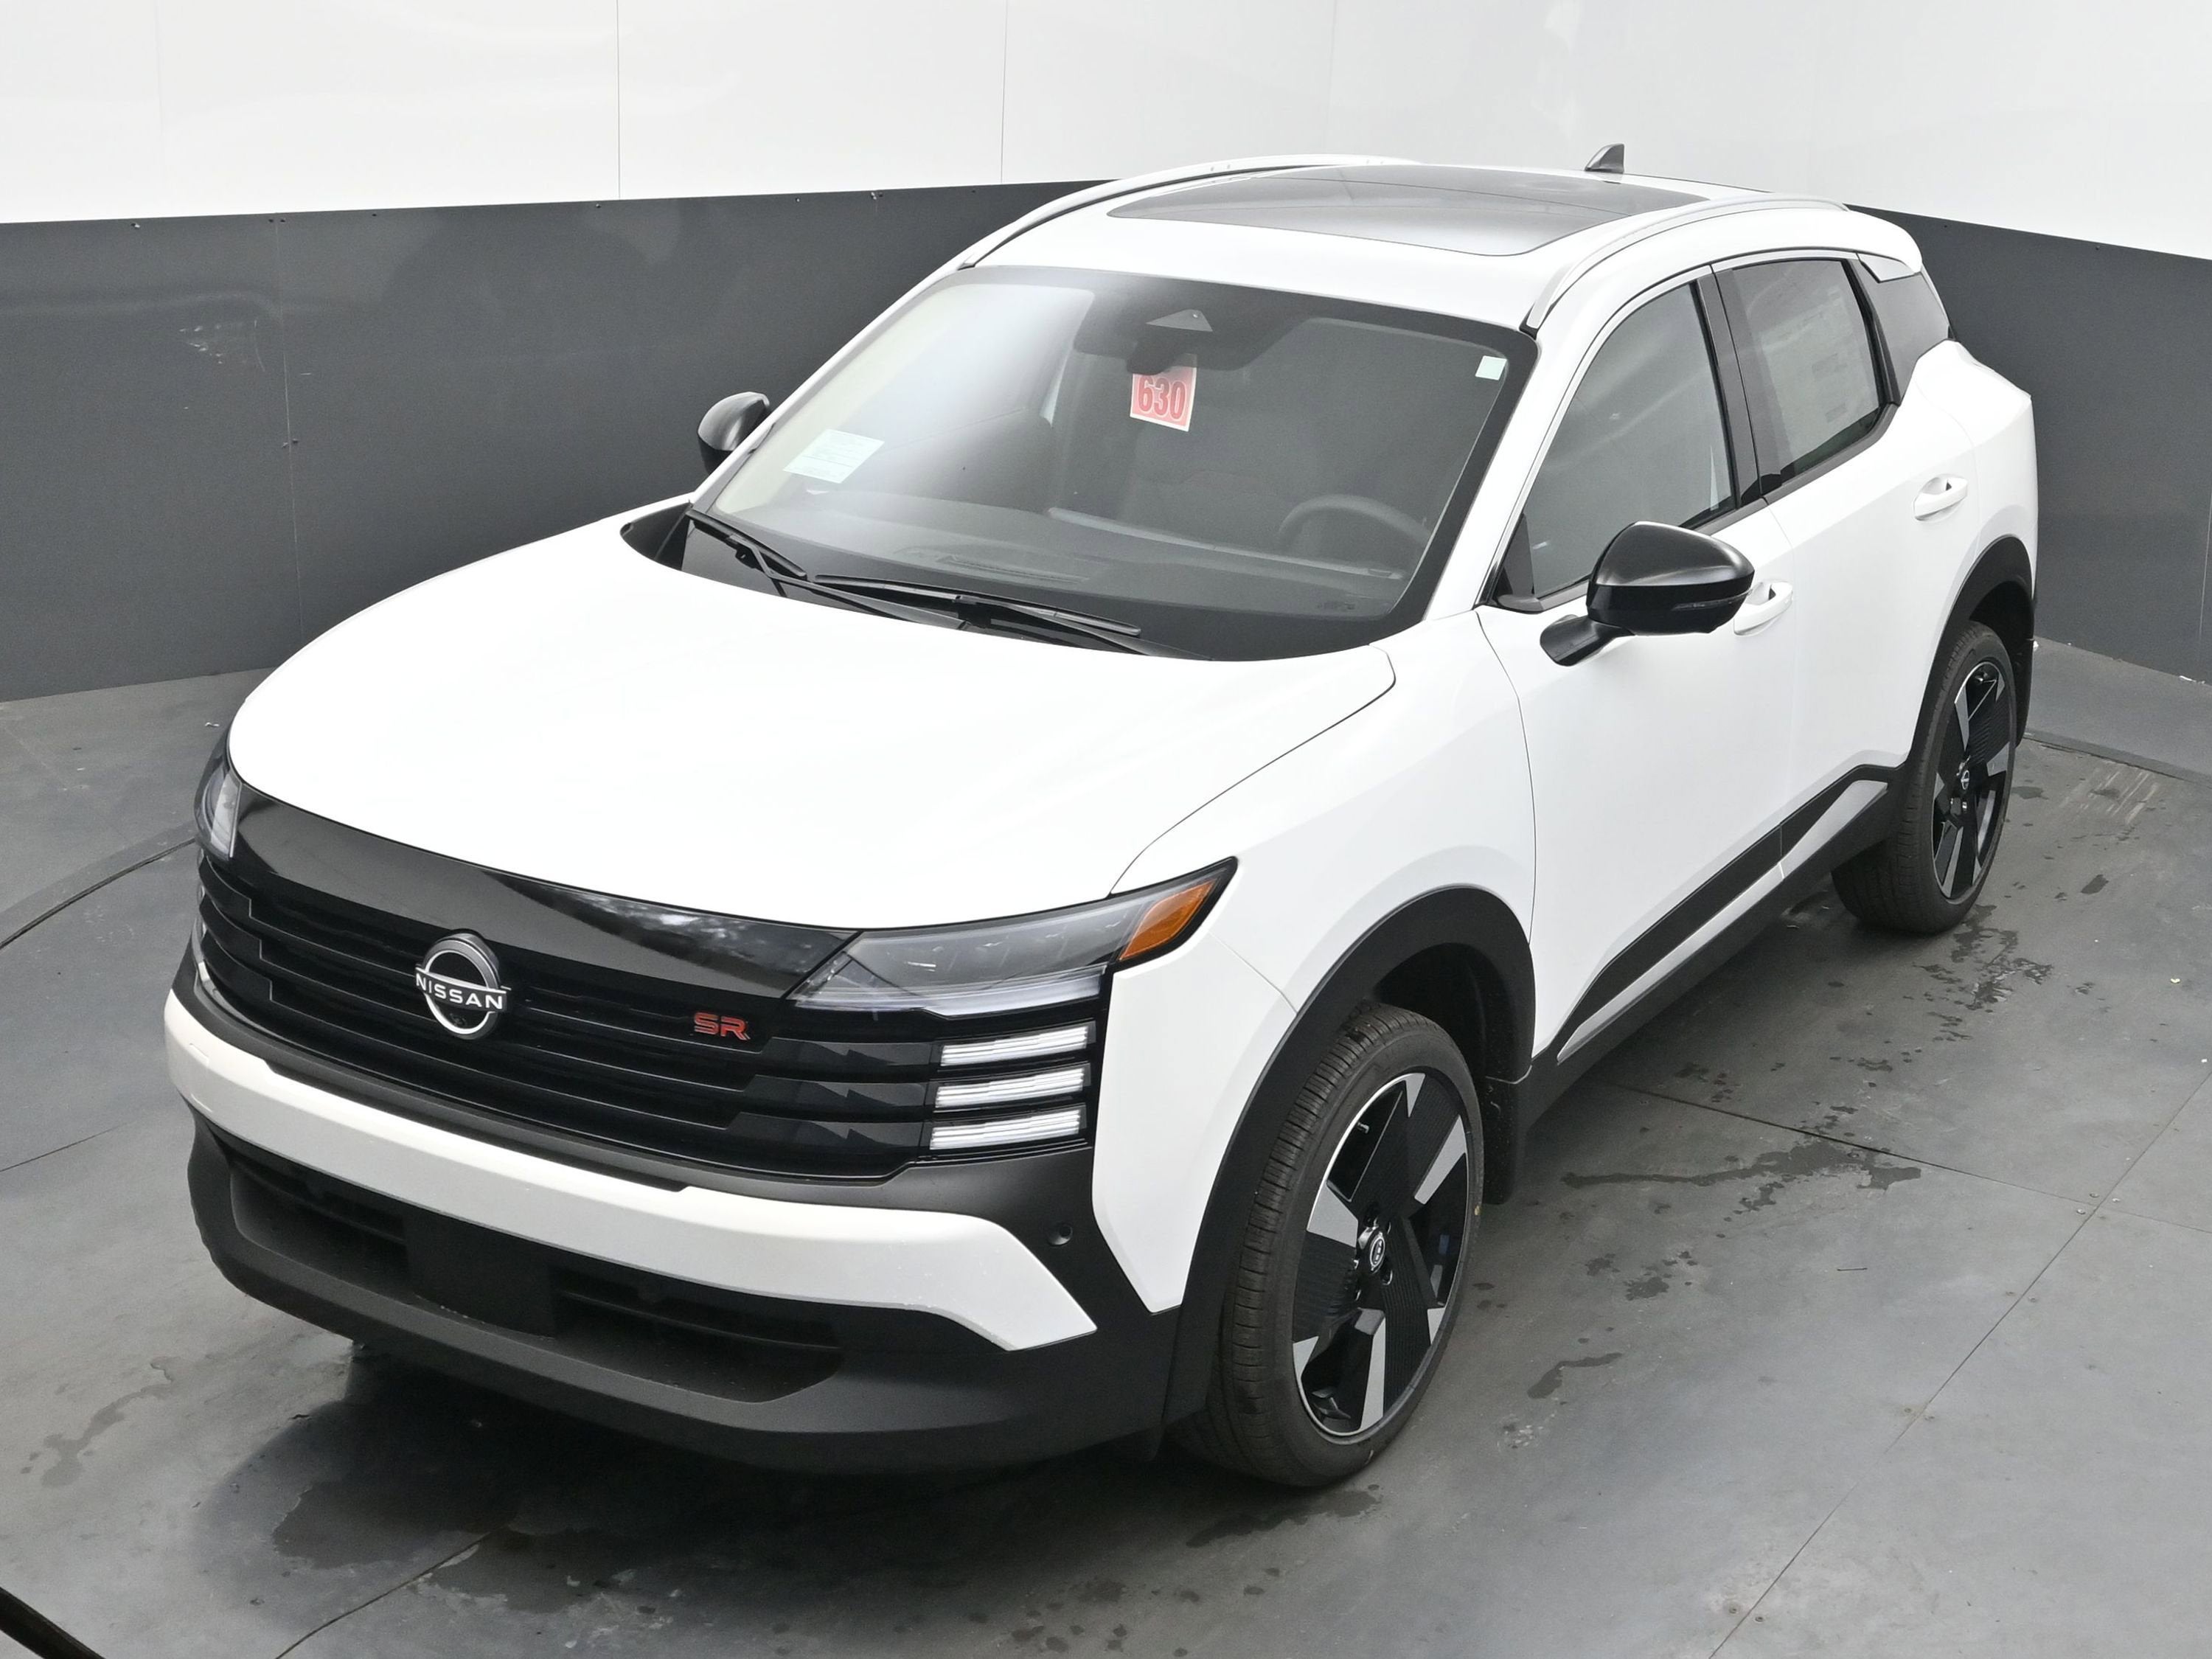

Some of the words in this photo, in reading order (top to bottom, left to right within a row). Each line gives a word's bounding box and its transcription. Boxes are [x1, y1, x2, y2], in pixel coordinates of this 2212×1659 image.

[1138, 375, 1186, 421] 630
[416, 973, 503, 1009] NISSAN
[694, 1012, 751, 1040] SR
